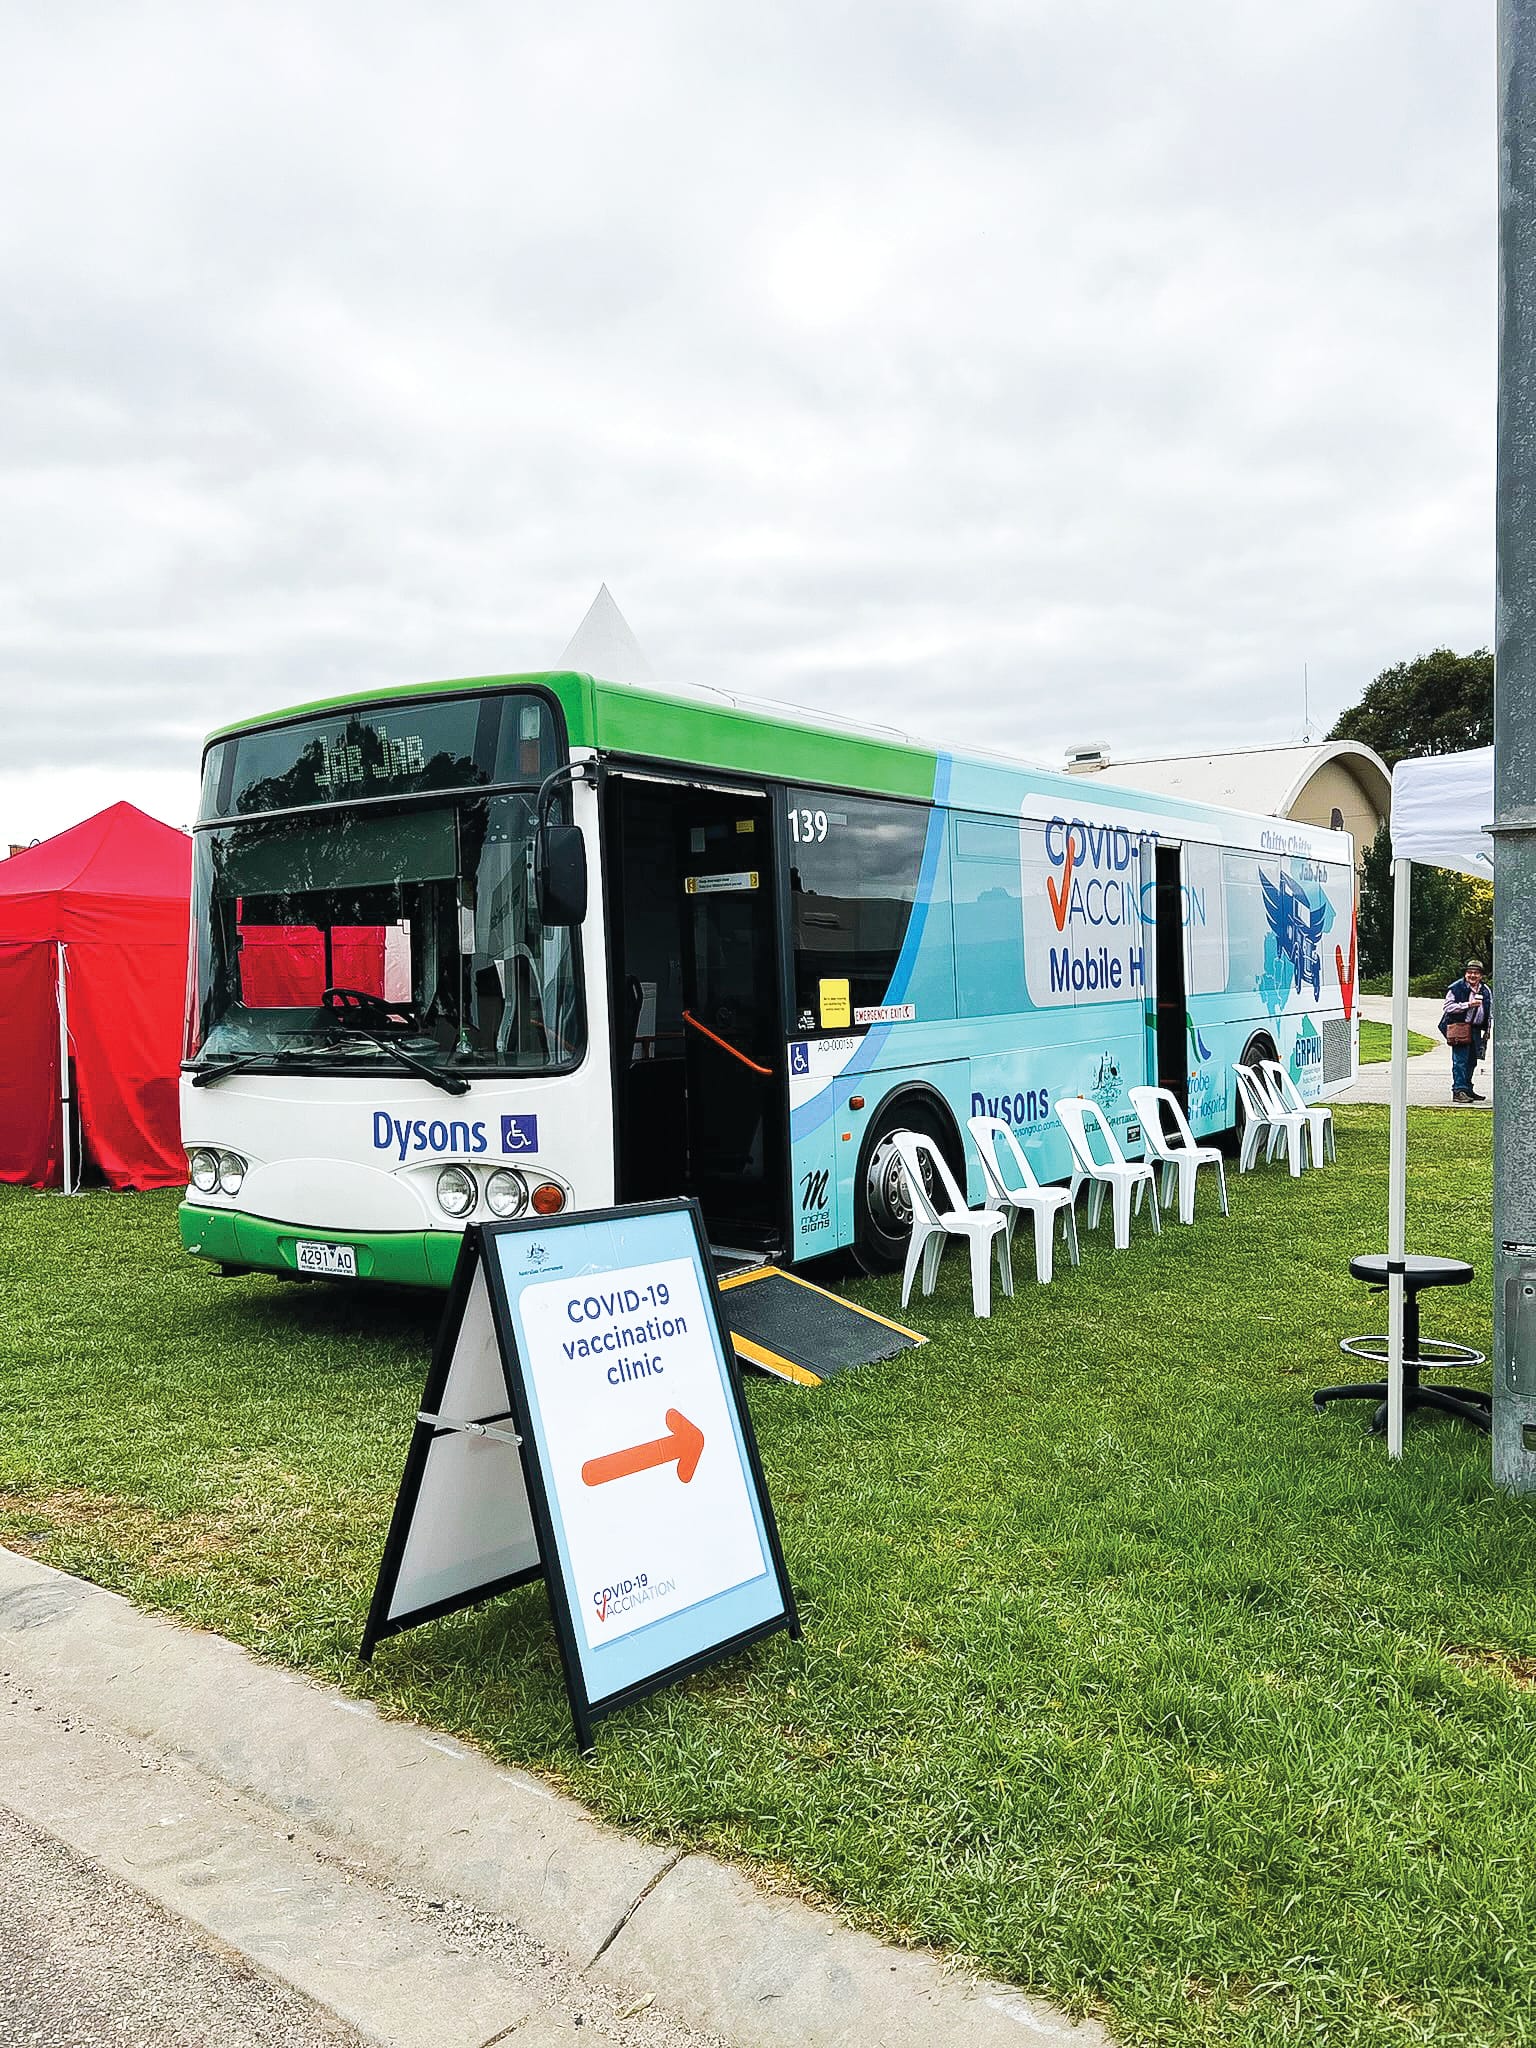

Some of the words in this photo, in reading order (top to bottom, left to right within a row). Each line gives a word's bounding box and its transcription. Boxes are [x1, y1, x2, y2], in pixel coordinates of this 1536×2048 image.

[787, 808, 829, 843] 139
[1046, 816, 1160, 870] COVID-
[1260, 830, 1288, 852] Chitty
[1287, 836, 1313, 857] Chitty
[1050, 947, 1122, 993] Mobile
[855, 1007, 889, 1022] EMERGENCY
[889, 1006, 903, 1020] EXIT
[1295, 1036, 1322, 1067] GRPHU
[971, 1088, 1049, 1141] Dysons
[373, 1111, 488, 1161] Dysons
[300, 1249, 328, 1267] 4291
[567, 1283, 670, 1323] COVID-19
[562, 1316, 688, 1360] vaccination
[607, 1352, 664, 1385] clinic
[593, 1573, 648, 1606] COVID-19
